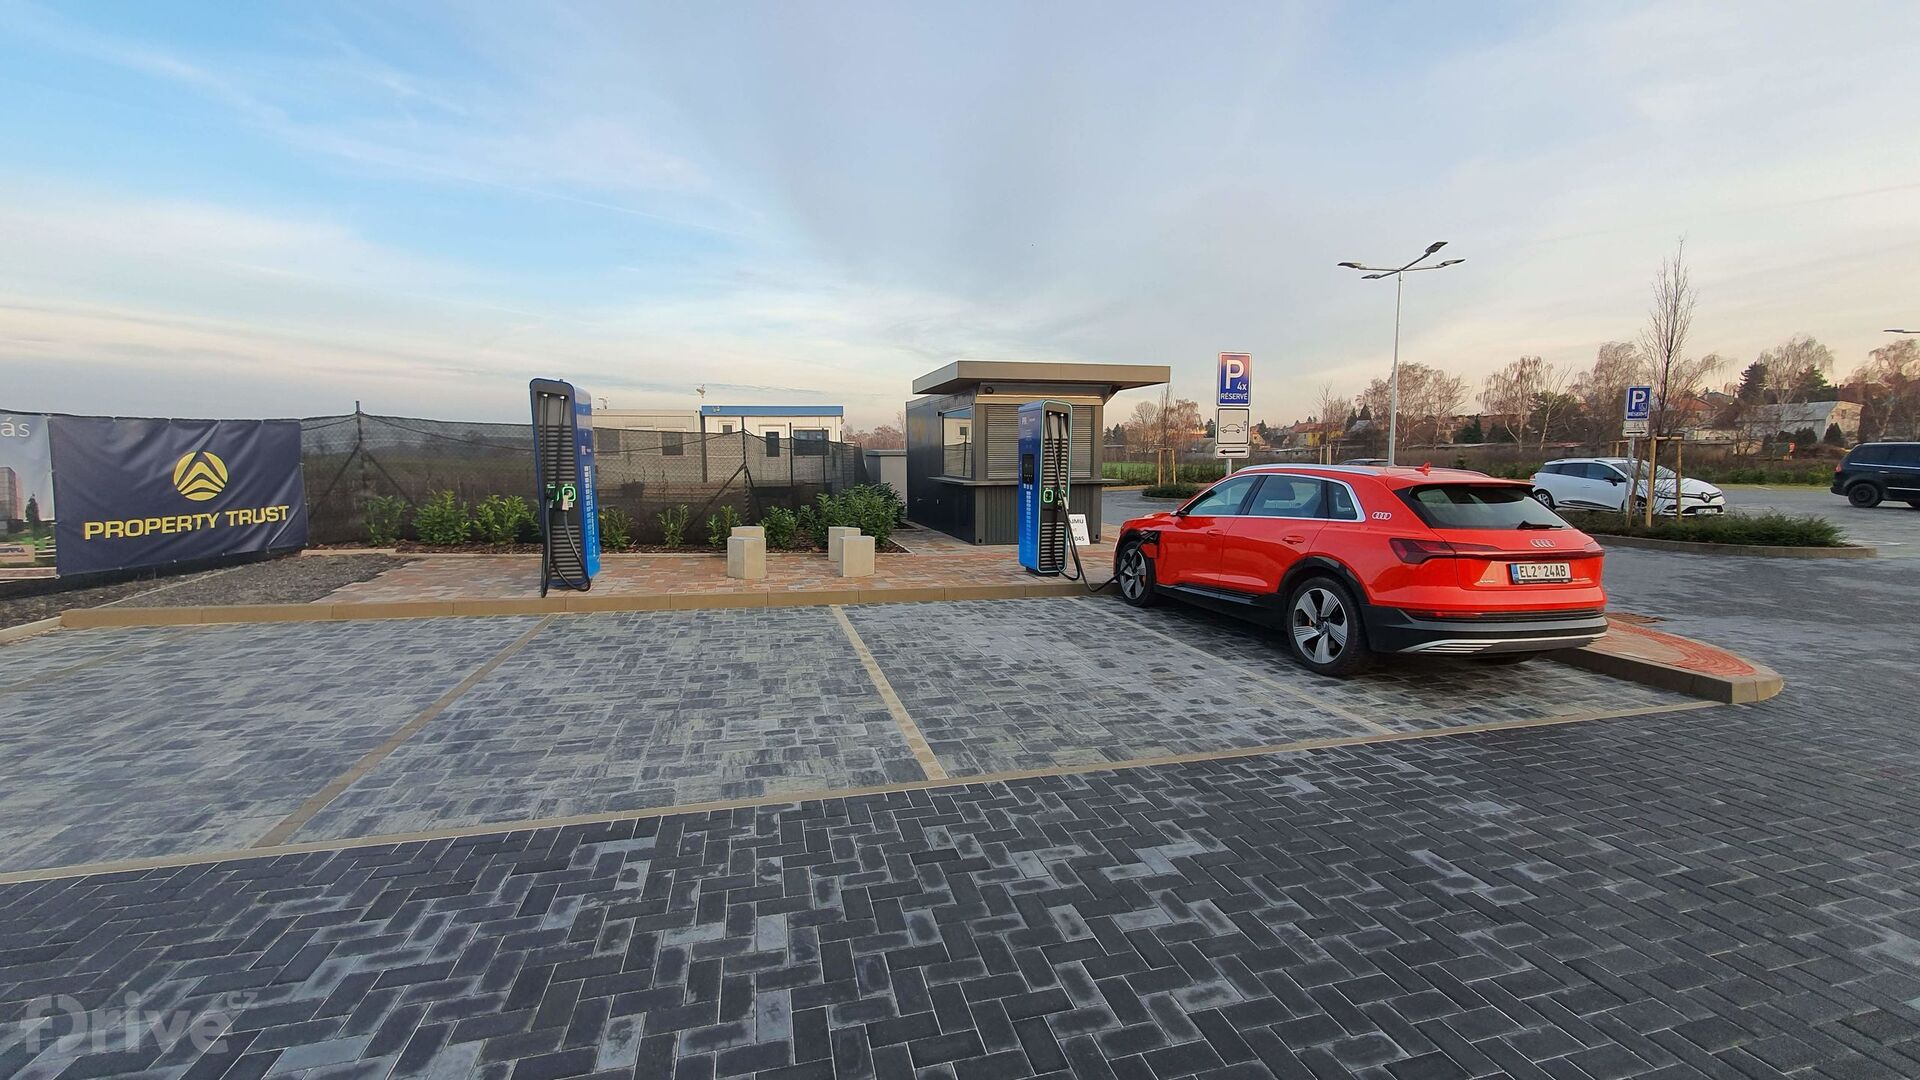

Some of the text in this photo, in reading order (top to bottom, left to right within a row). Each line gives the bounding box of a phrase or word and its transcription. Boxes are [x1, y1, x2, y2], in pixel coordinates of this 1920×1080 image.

[1225, 360, 1245, 389] P
[1237, 381, 1247, 390] 4x
[1220, 392, 1248, 400] RÉSERVÉ
[1631, 390, 1647, 410] P
[84, 504, 290, 541] PROPERTY TRUST
[1520, 564, 1566, 577] EL2 24AB
